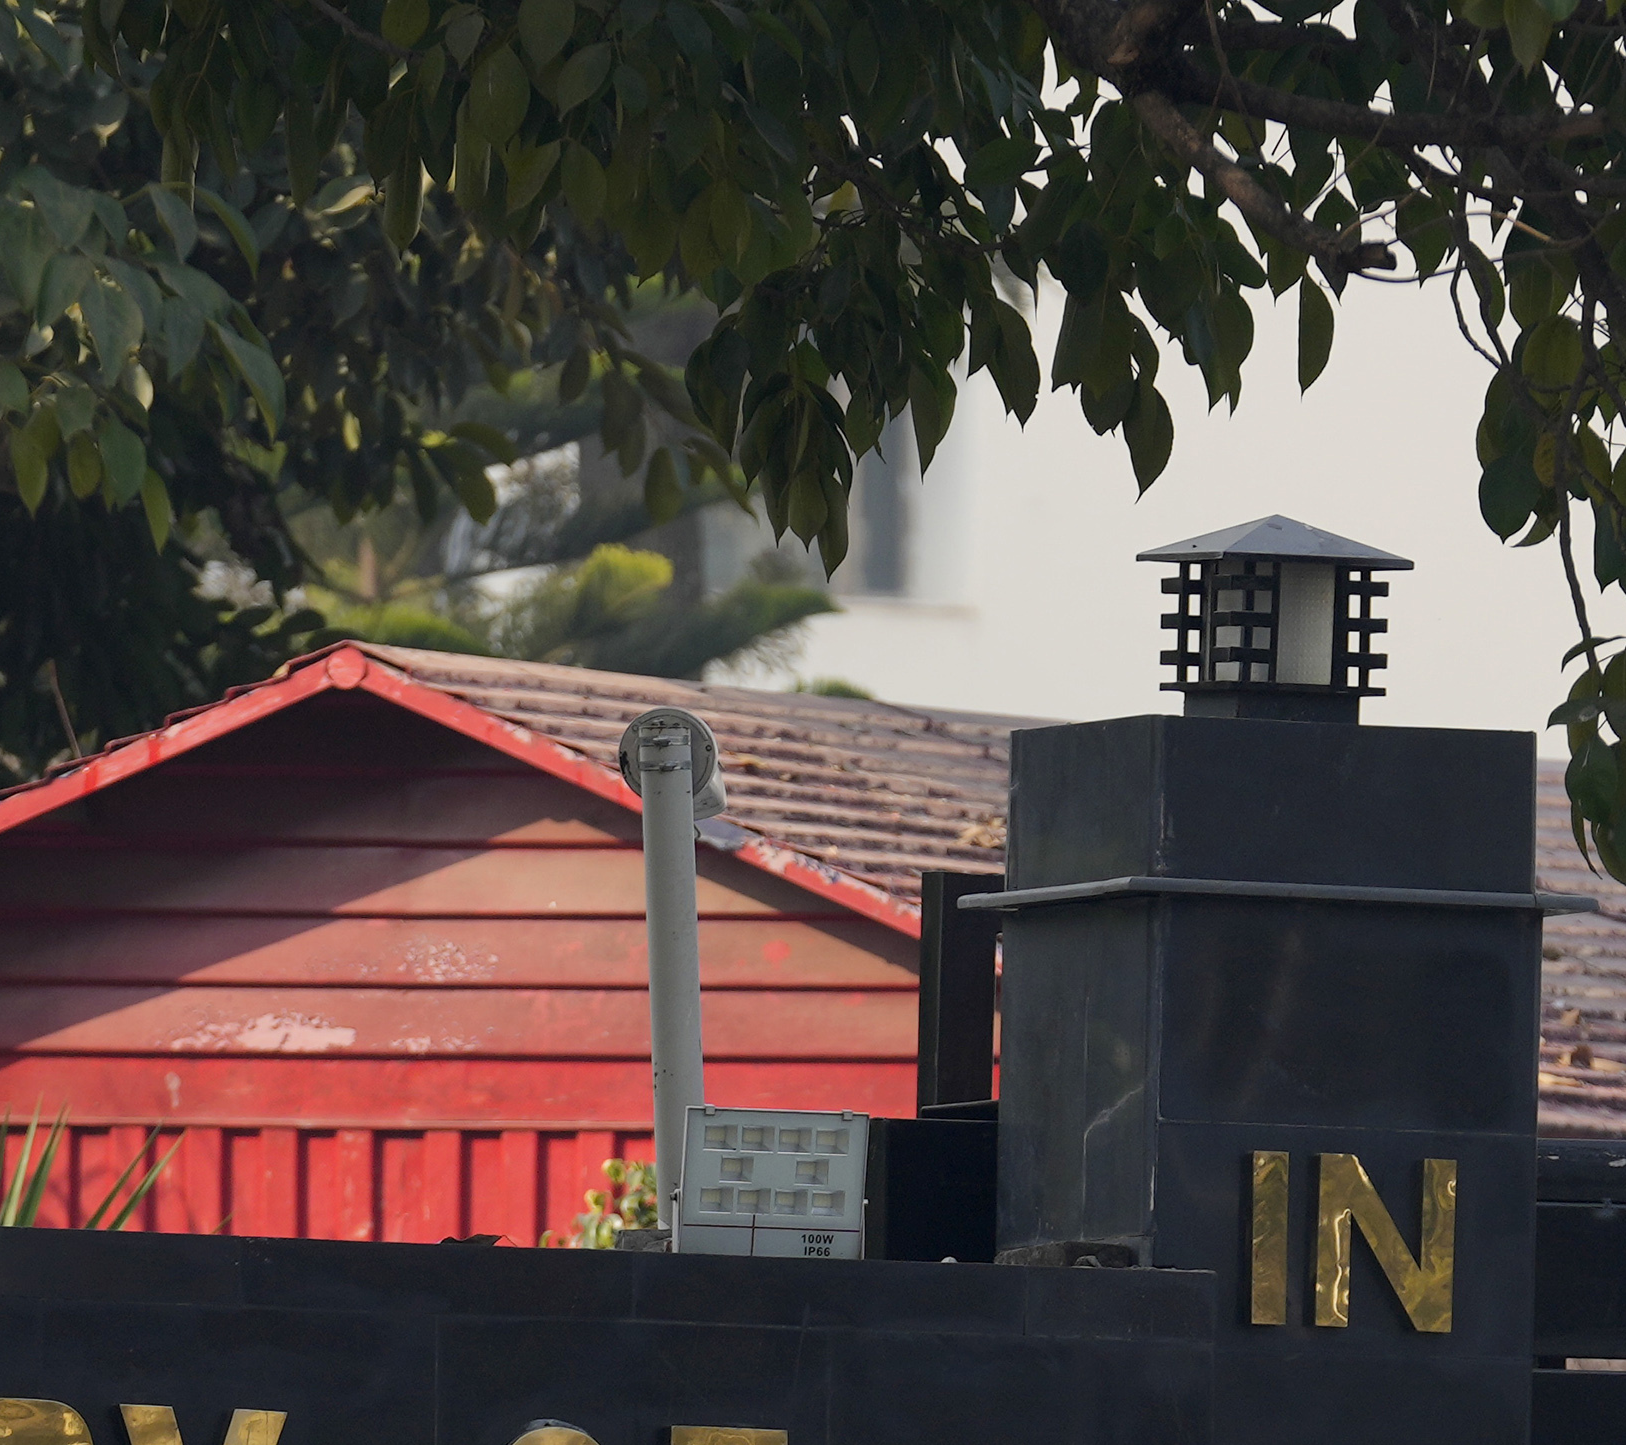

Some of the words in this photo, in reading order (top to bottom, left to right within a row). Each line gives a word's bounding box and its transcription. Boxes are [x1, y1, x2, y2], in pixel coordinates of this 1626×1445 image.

[800, 1233, 835, 1245] 100W
[1250, 1150, 1458, 1333] IN
[803, 1245, 832, 1258] IP66
